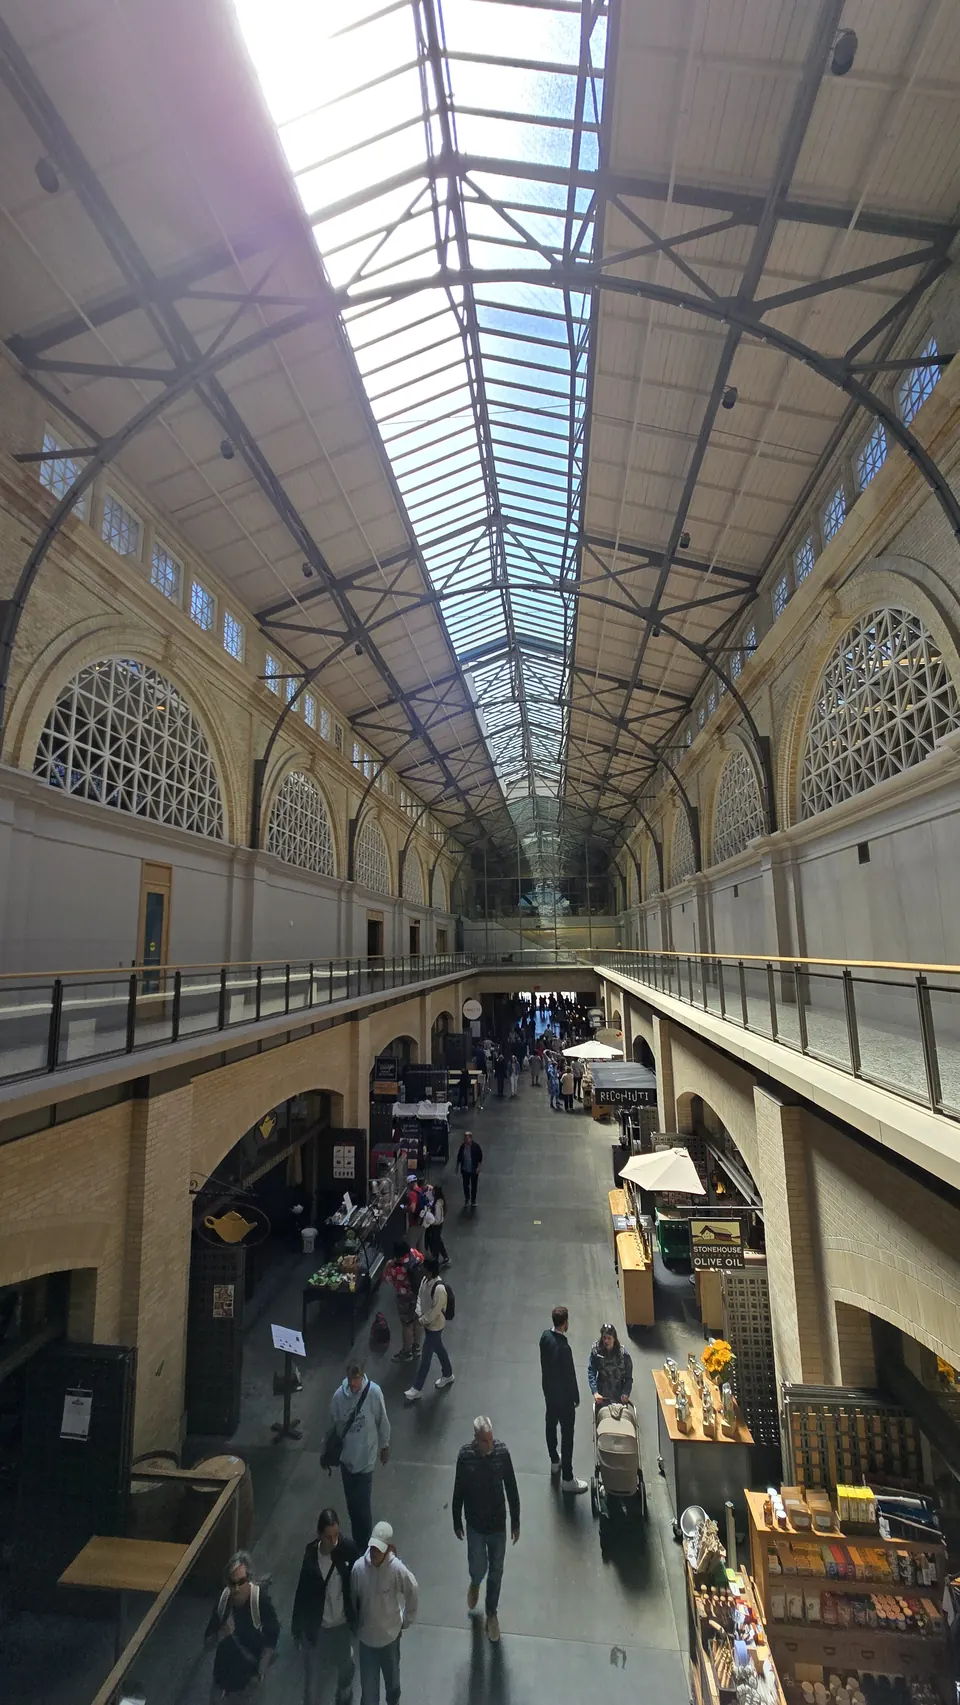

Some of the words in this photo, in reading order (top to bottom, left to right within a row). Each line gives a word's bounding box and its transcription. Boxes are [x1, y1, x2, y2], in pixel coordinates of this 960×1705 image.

[693, 1246, 742, 1254] STONEHOUSE
[693, 1257, 723, 1266] OLIVE
[725, 1258, 743, 1267] OIL
